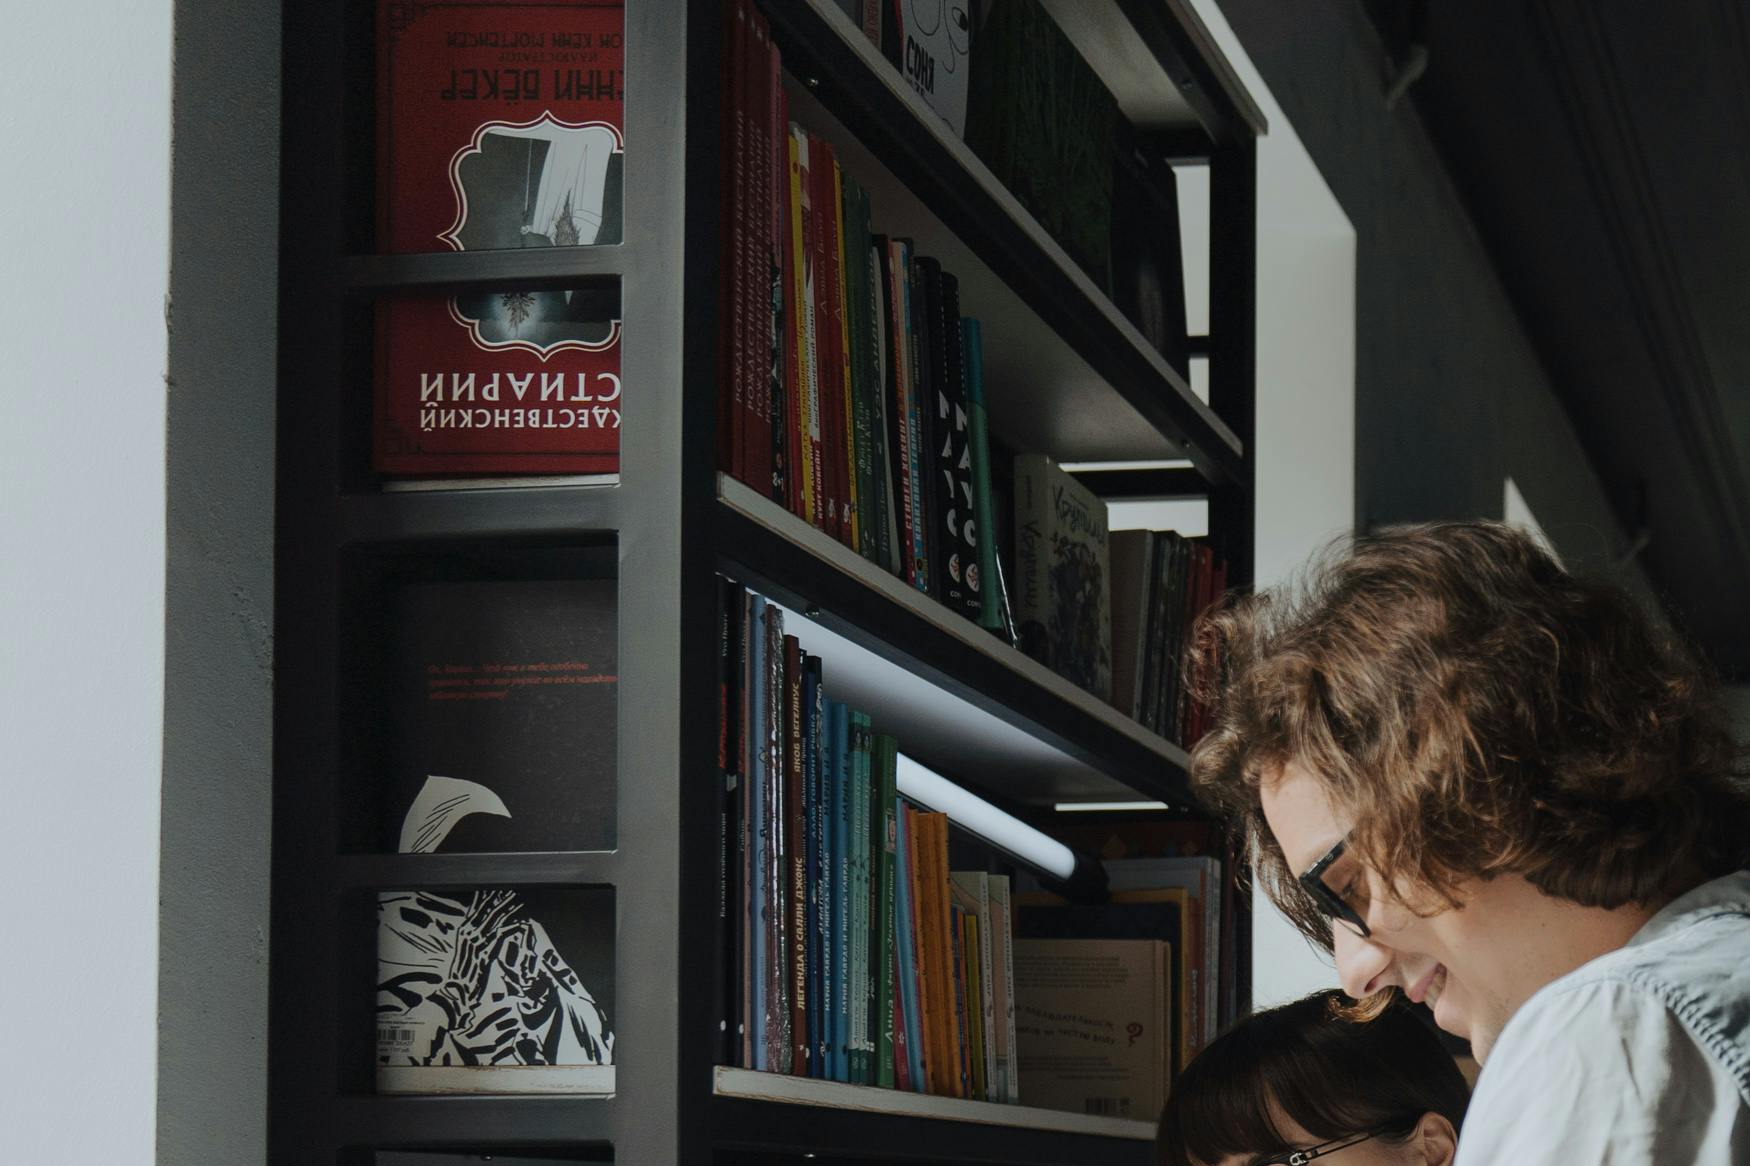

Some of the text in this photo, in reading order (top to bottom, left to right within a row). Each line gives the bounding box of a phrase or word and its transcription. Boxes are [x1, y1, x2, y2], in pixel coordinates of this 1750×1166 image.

[440, 69, 540, 105] БЁКЕР
[735, 225, 744, 404] РОЖДЕСТВЕНСКИЙ
[795, 857, 804, 900] ДЖОНС
[795, 903, 804, 941] САЛЛИ
[796, 954, 805, 1010] ЛЕГЕНДА
